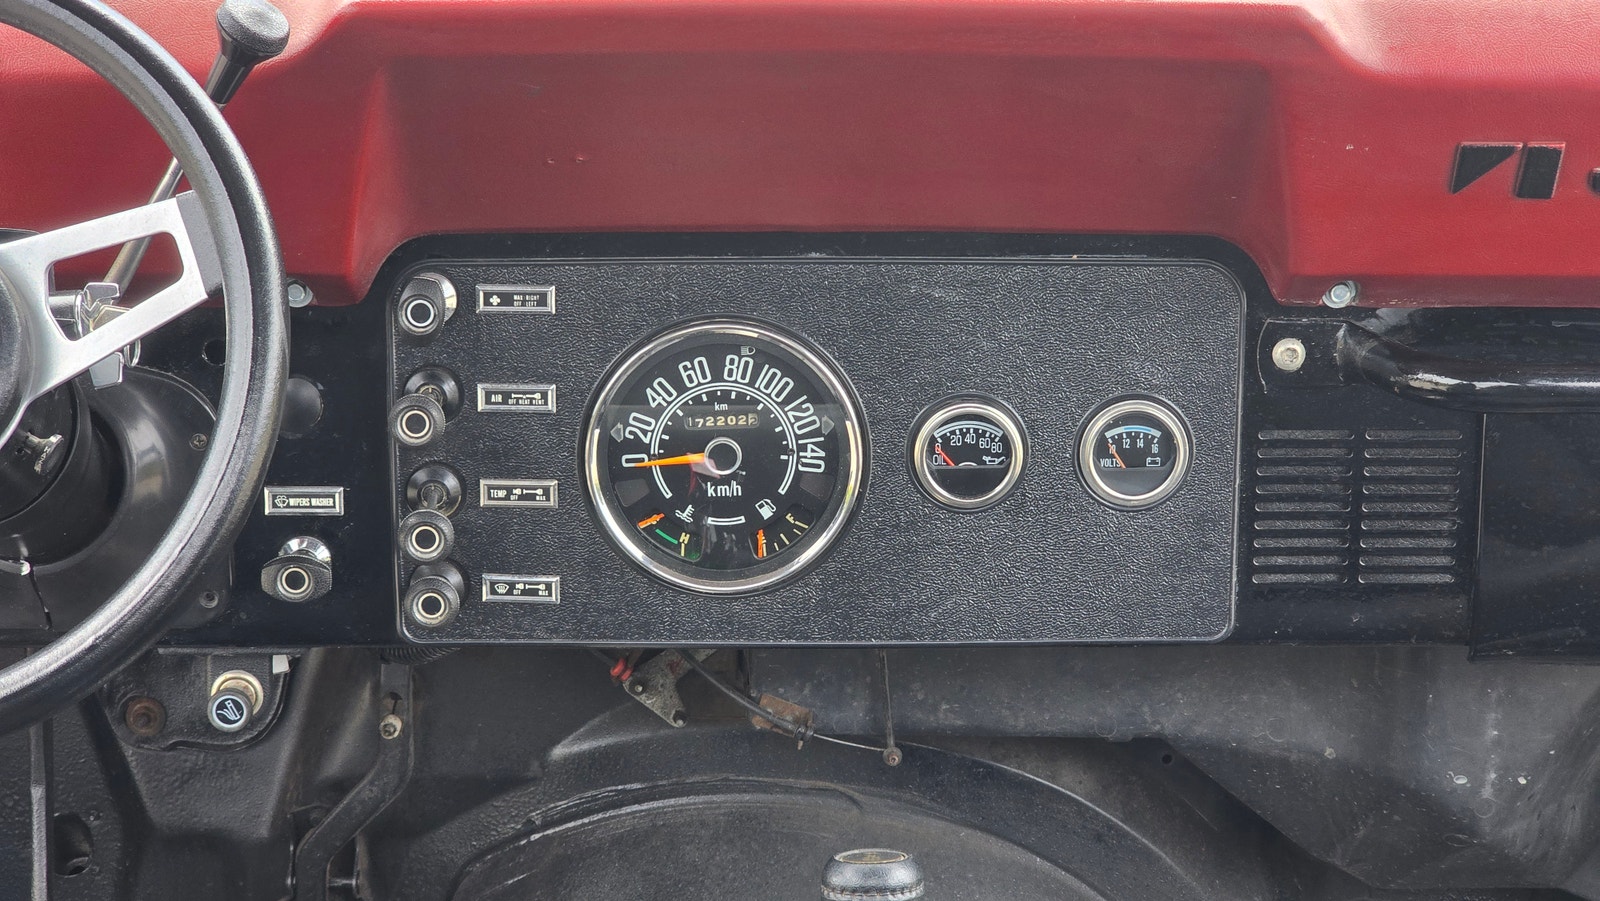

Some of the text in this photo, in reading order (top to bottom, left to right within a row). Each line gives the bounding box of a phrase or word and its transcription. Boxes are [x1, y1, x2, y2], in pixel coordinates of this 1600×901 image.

[678, 356, 712, 388] 60
[723, 354, 754, 384] 80
[754, 364, 795, 403] 100
[645, 377, 678, 408] 40
[491, 394, 503, 403] AIR
[714, 402, 729, 411] km
[784, 395, 821, 435] 120
[625, 412, 656, 444] 20
[950, 435, 962, 446] 20
[964, 433, 976, 444] 40
[979, 437, 991, 449] 60
[1122, 438, 1131, 449] 12
[1136, 438, 1144, 449] 14
[991, 442, 1003, 453] 80
[1151, 444, 1159, 454] 16
[797, 436, 826, 473] 140
[932, 454, 947, 465] OIL
[621, 453, 649, 468] 0
[1100, 458, 1121, 468] VOLTS
[490, 489, 507, 498] TEMP
[707, 479, 743, 498] km/h
[288, 497, 334, 507] WIPERS WASHER
[785, 512, 796, 525] F
[679, 532, 690, 545] H
